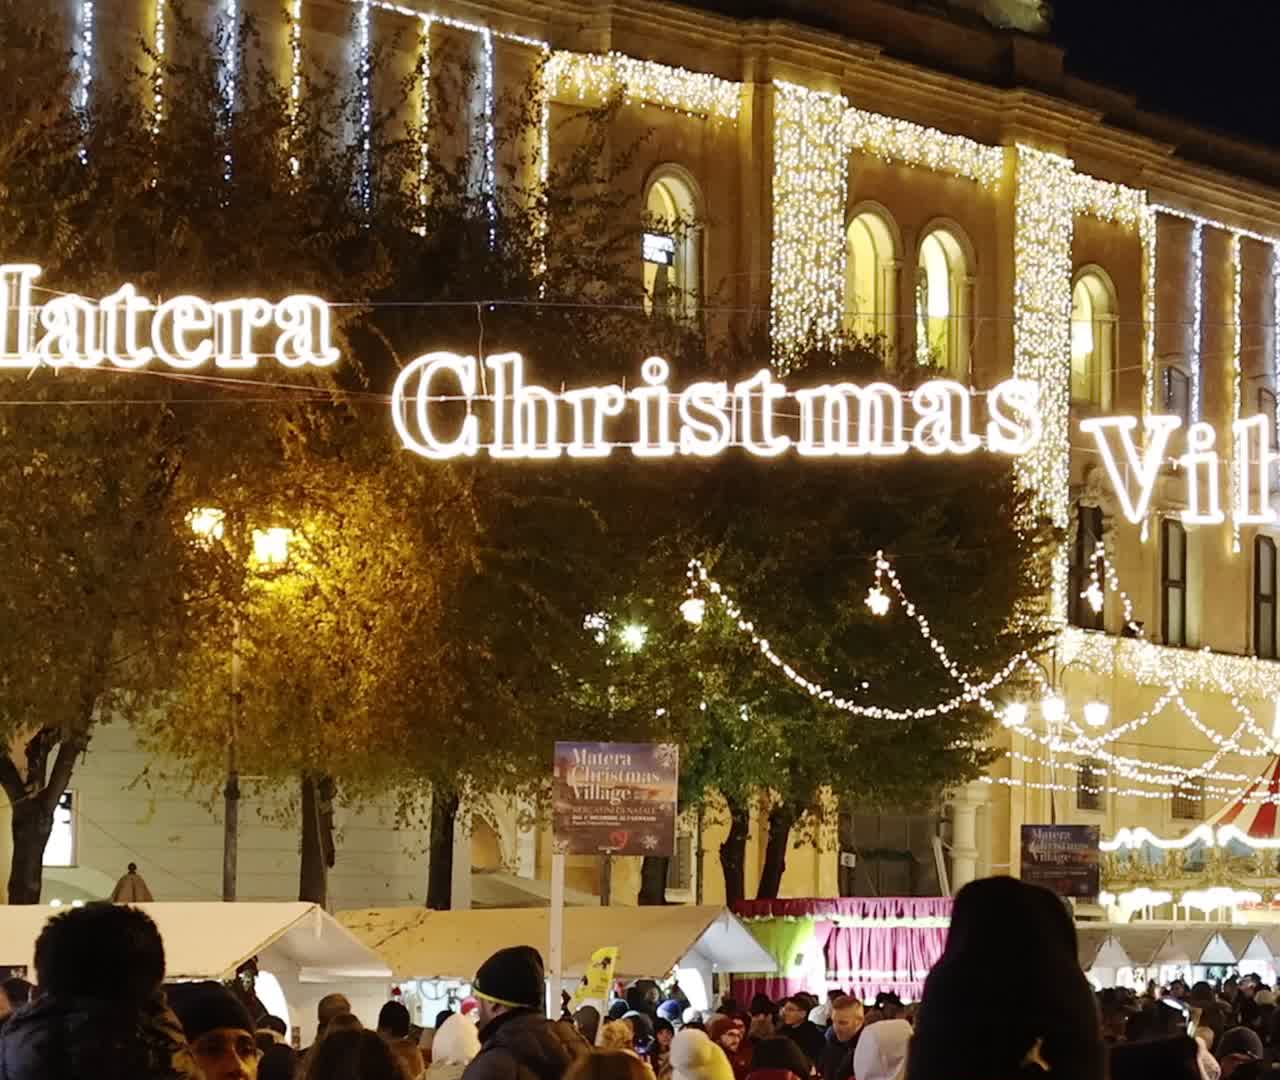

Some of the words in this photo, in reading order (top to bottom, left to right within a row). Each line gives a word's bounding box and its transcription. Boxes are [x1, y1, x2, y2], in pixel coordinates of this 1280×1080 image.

[391, 351, 1043, 459] Christmas
[572, 747, 632, 766] Matera
[567, 766, 660, 787] Christmas
[571, 784, 632, 806] Village
